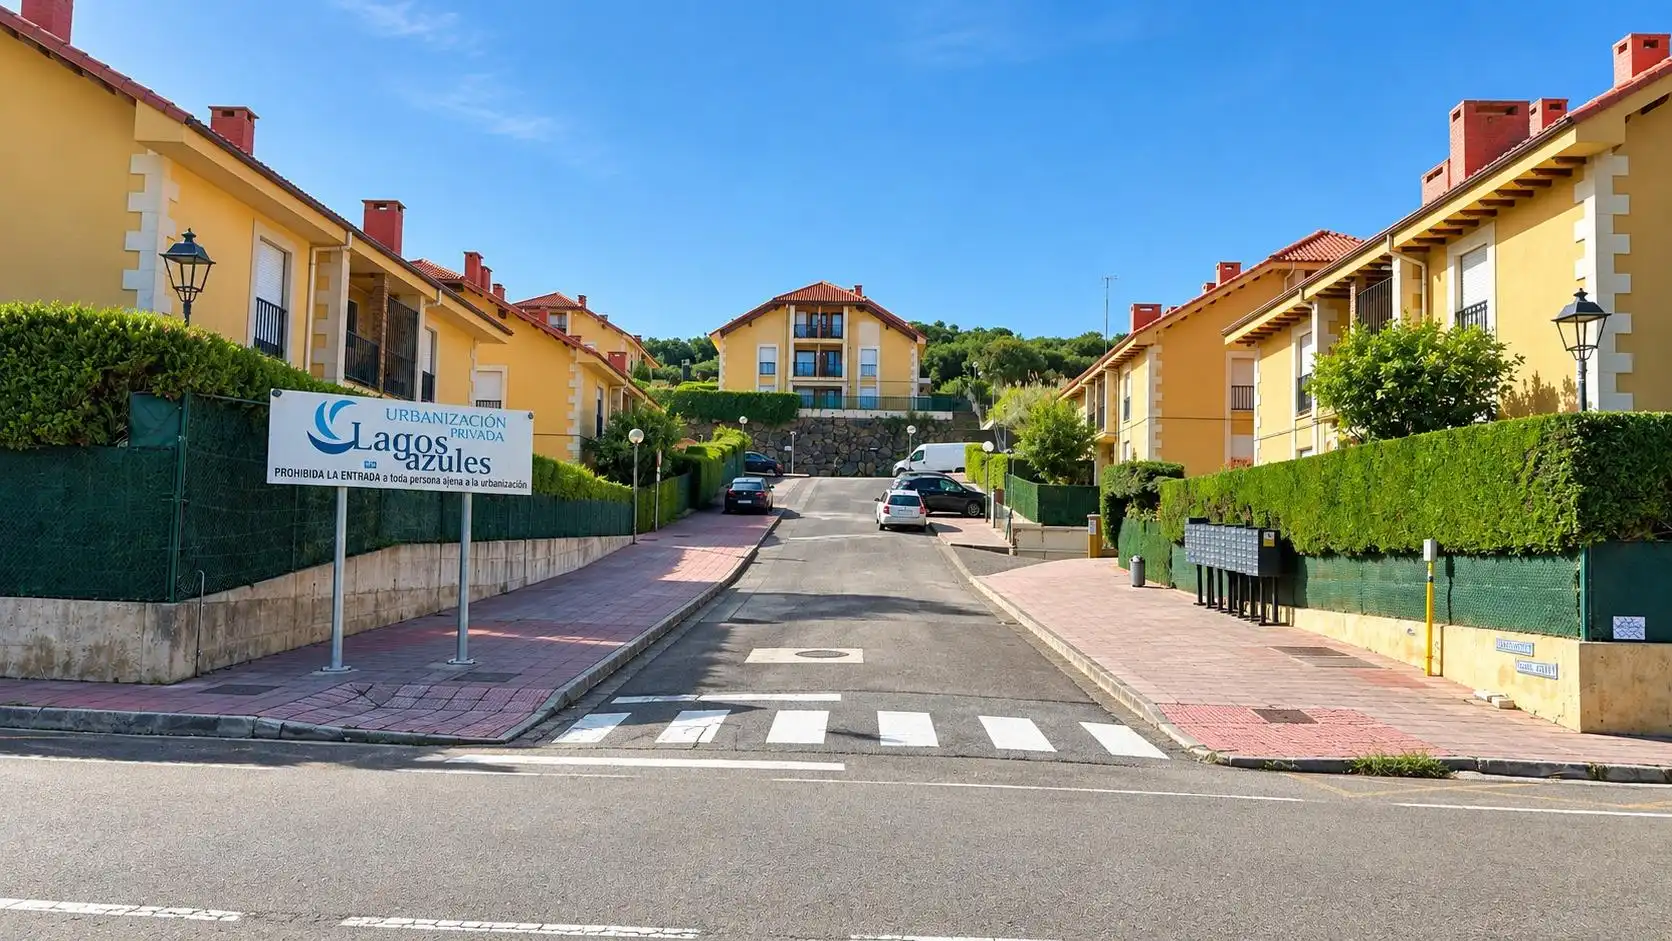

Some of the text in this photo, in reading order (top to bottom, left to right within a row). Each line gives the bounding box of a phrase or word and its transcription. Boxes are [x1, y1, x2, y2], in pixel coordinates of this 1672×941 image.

[386, 408, 506, 428] URBANIZACIÓN
[352, 422, 448, 461] Lagos
[451, 428, 504, 442] PRIVADA
[406, 449, 491, 474] azules
[275, 468, 324, 479] PROHIBIDA
[327, 470, 339, 480] LA
[341, 471, 380, 482] ENTRADA
[390, 474, 407, 483] toda
[410, 476, 441, 486] persona
[443, 476, 463, 488] ajena
[472, 478, 478, 486] la
[481, 479, 527, 489] urbanización
